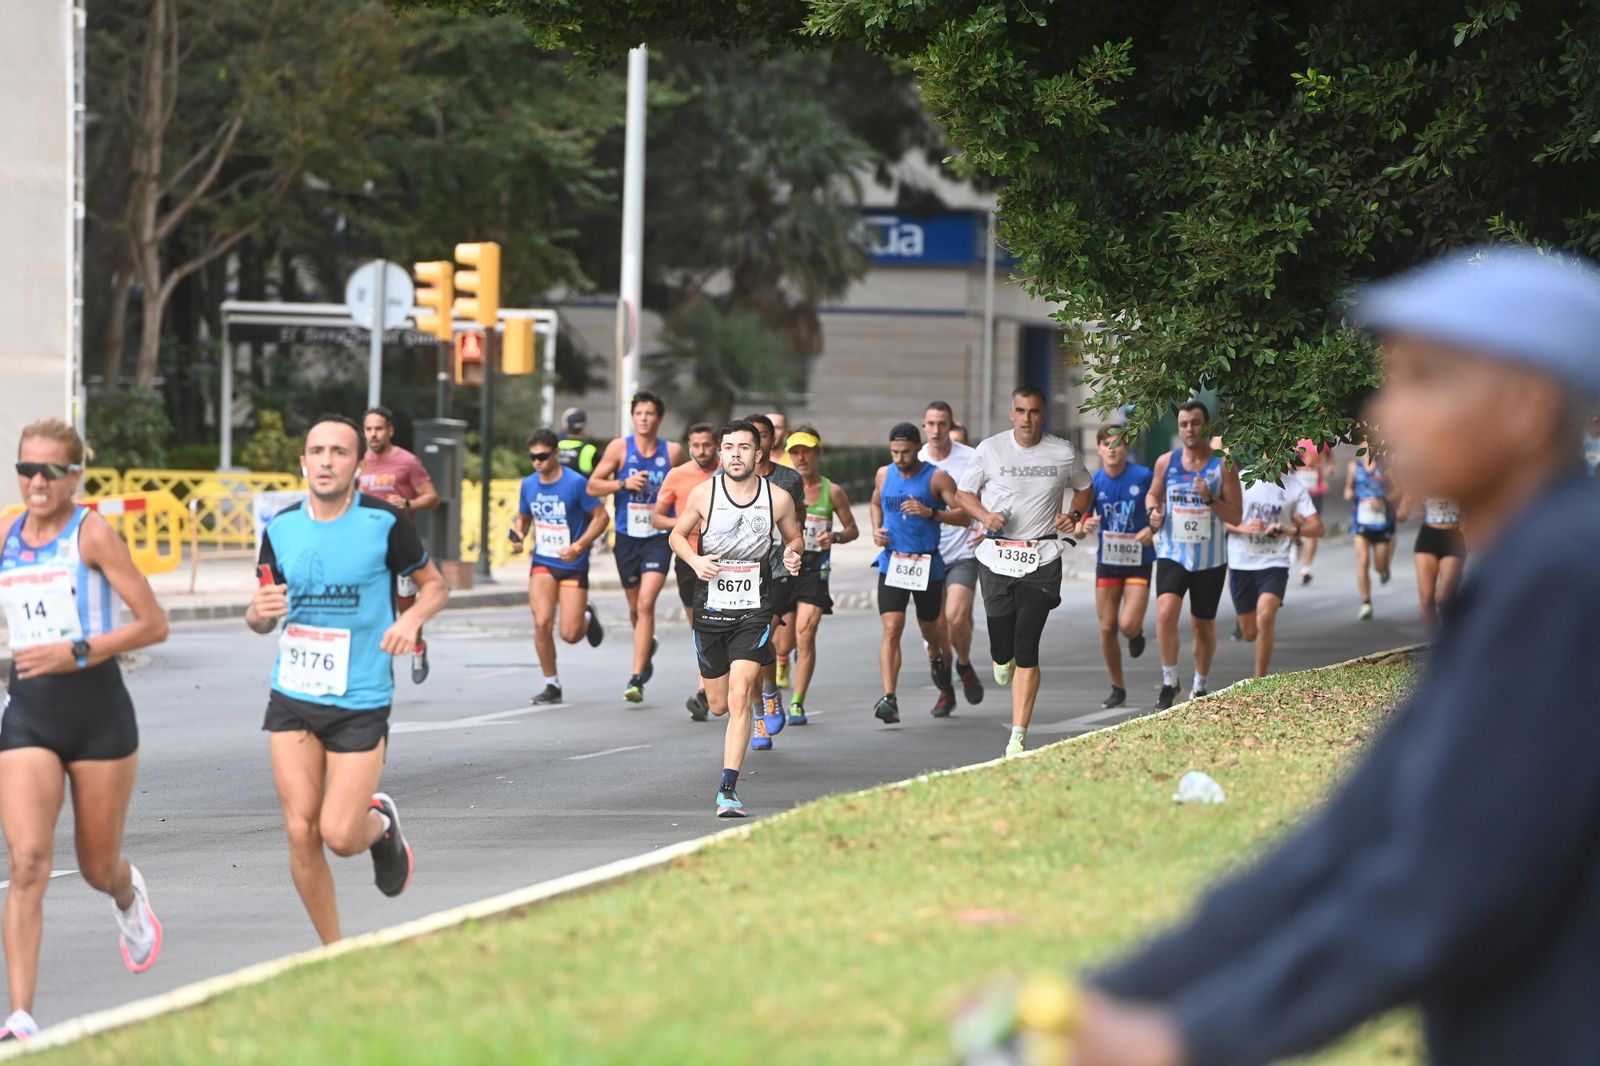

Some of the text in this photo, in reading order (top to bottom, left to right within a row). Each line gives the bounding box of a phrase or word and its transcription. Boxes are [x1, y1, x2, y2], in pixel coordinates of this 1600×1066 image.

[530, 501, 566, 517] RCM
[1102, 500, 1136, 518] RCM
[1184, 520, 1198, 532] 62
[1107, 543, 1139, 554] 11802
[997, 549, 1036, 565] 13385
[323, 583, 360, 596] XXXI
[717, 579, 752, 593] 6670
[22, 600, 48, 621] 14
[289, 647, 335, 672] 9176
